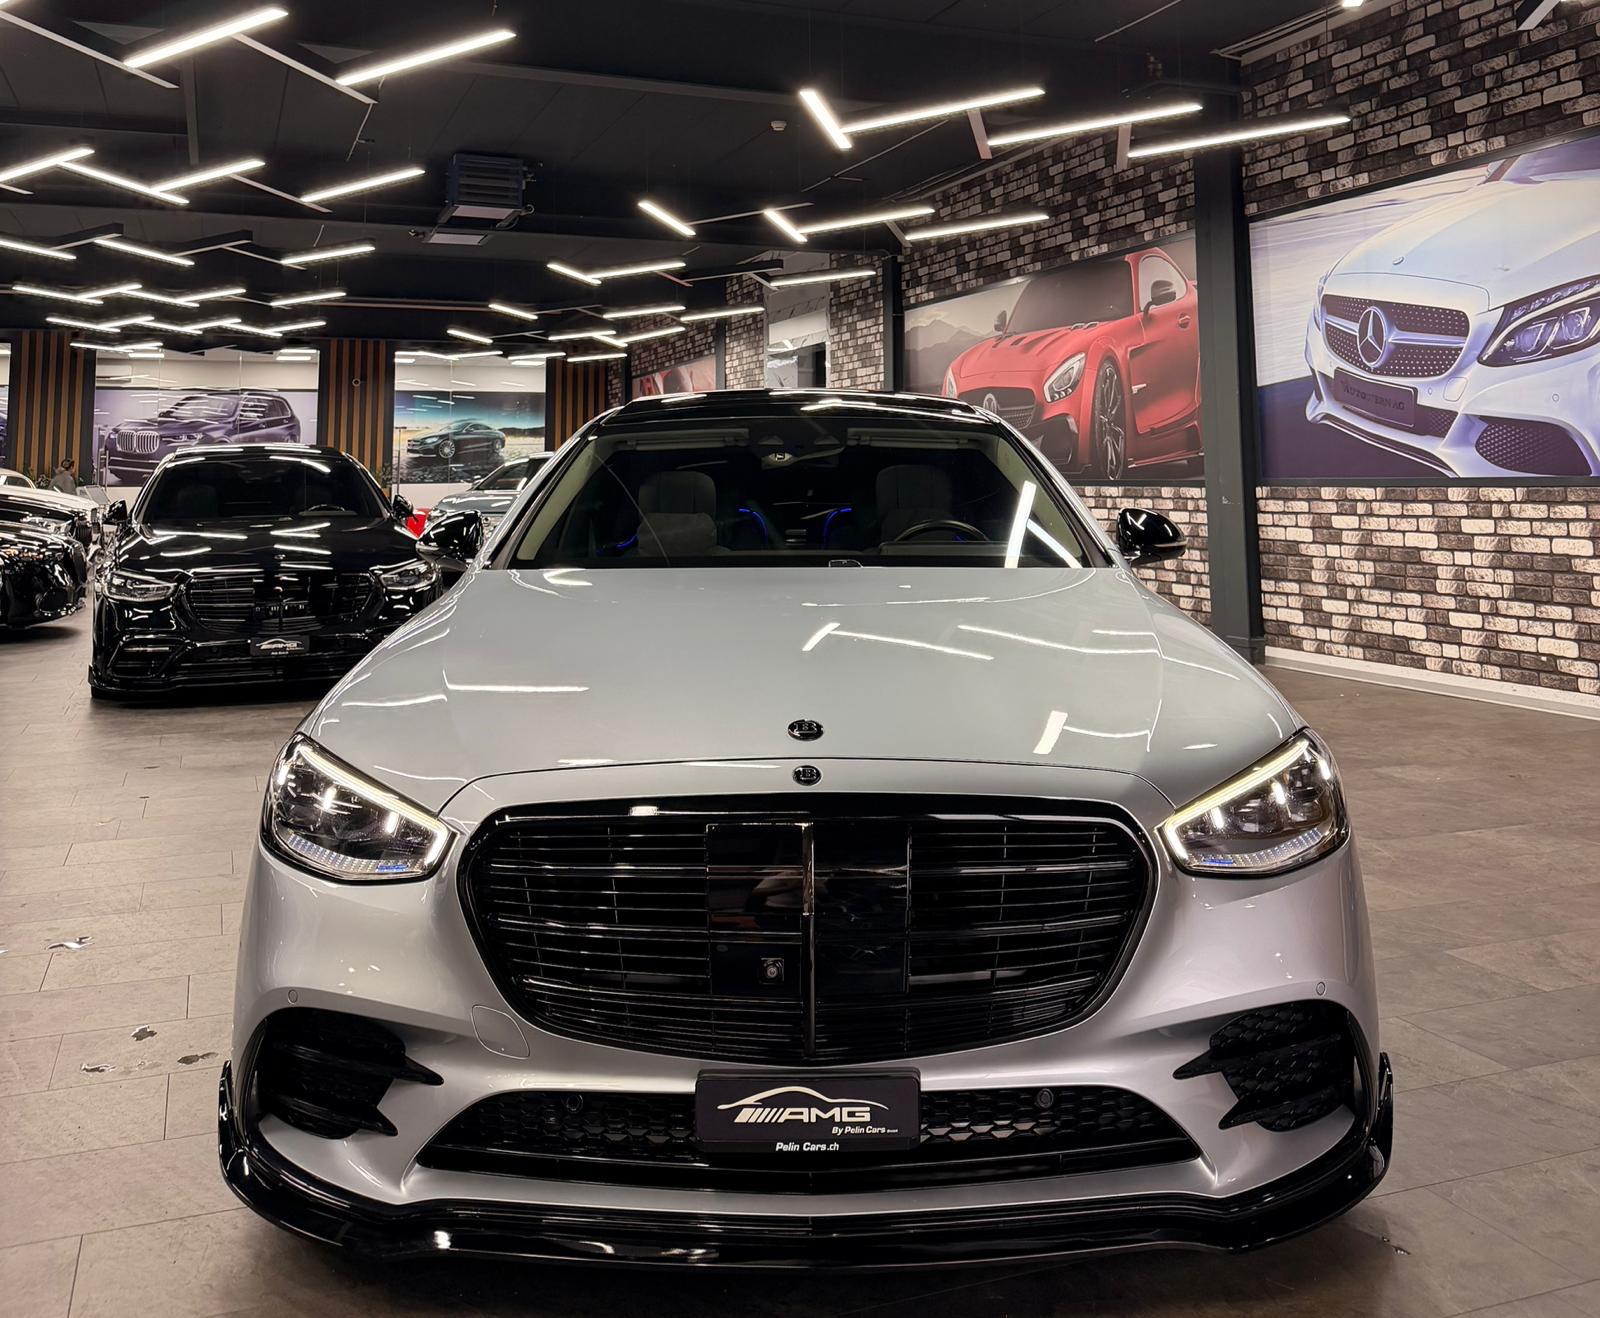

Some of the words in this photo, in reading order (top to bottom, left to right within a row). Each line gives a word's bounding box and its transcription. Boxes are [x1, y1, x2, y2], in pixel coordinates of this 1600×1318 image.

[831, 1126, 844, 1136] By
[844, 1125, 865, 1134] Pelin
[865, 1125, 886, 1134] Cars
[775, 1142, 800, 1152] Pelin
[802, 1142, 840, 1152] Cars.ch
